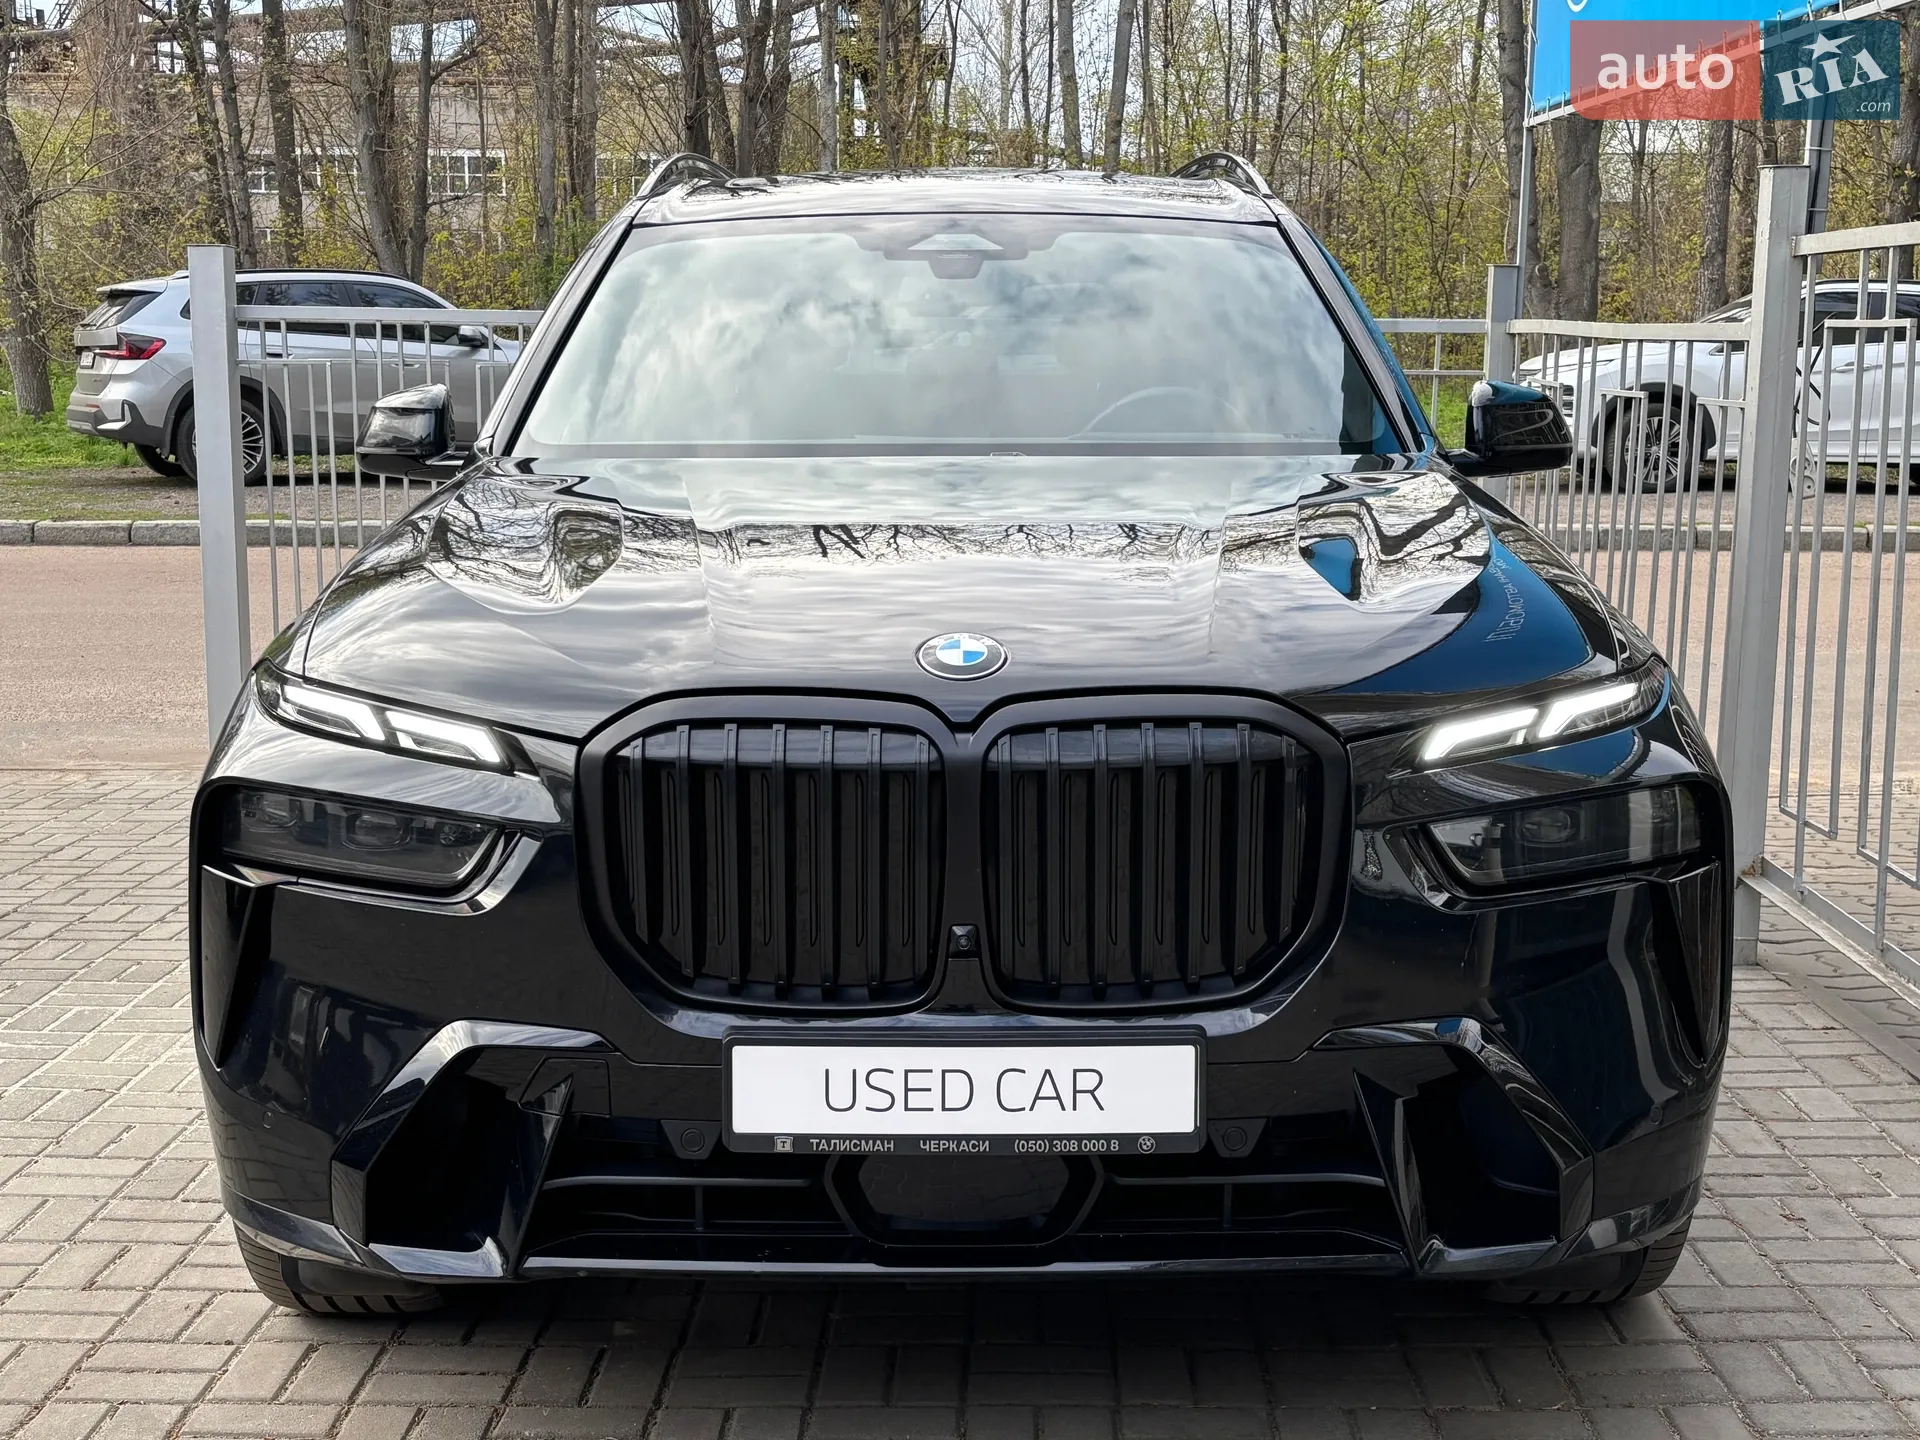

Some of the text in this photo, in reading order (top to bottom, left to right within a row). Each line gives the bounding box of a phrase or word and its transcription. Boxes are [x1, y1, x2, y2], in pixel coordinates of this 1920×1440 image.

[824, 1068, 1105, 1112] USED CAR
[810, 1139, 894, 1152] ТАЛИСМАН
[920, 1140, 991, 1152] ЧЕРКАСИ
[1014, 1139, 1050, 1153] (050)
[1053, 1140, 1078, 1152] 308
[1081, 1140, 1107, 1152] 000
[1110, 1139, 1120, 1151] 8
